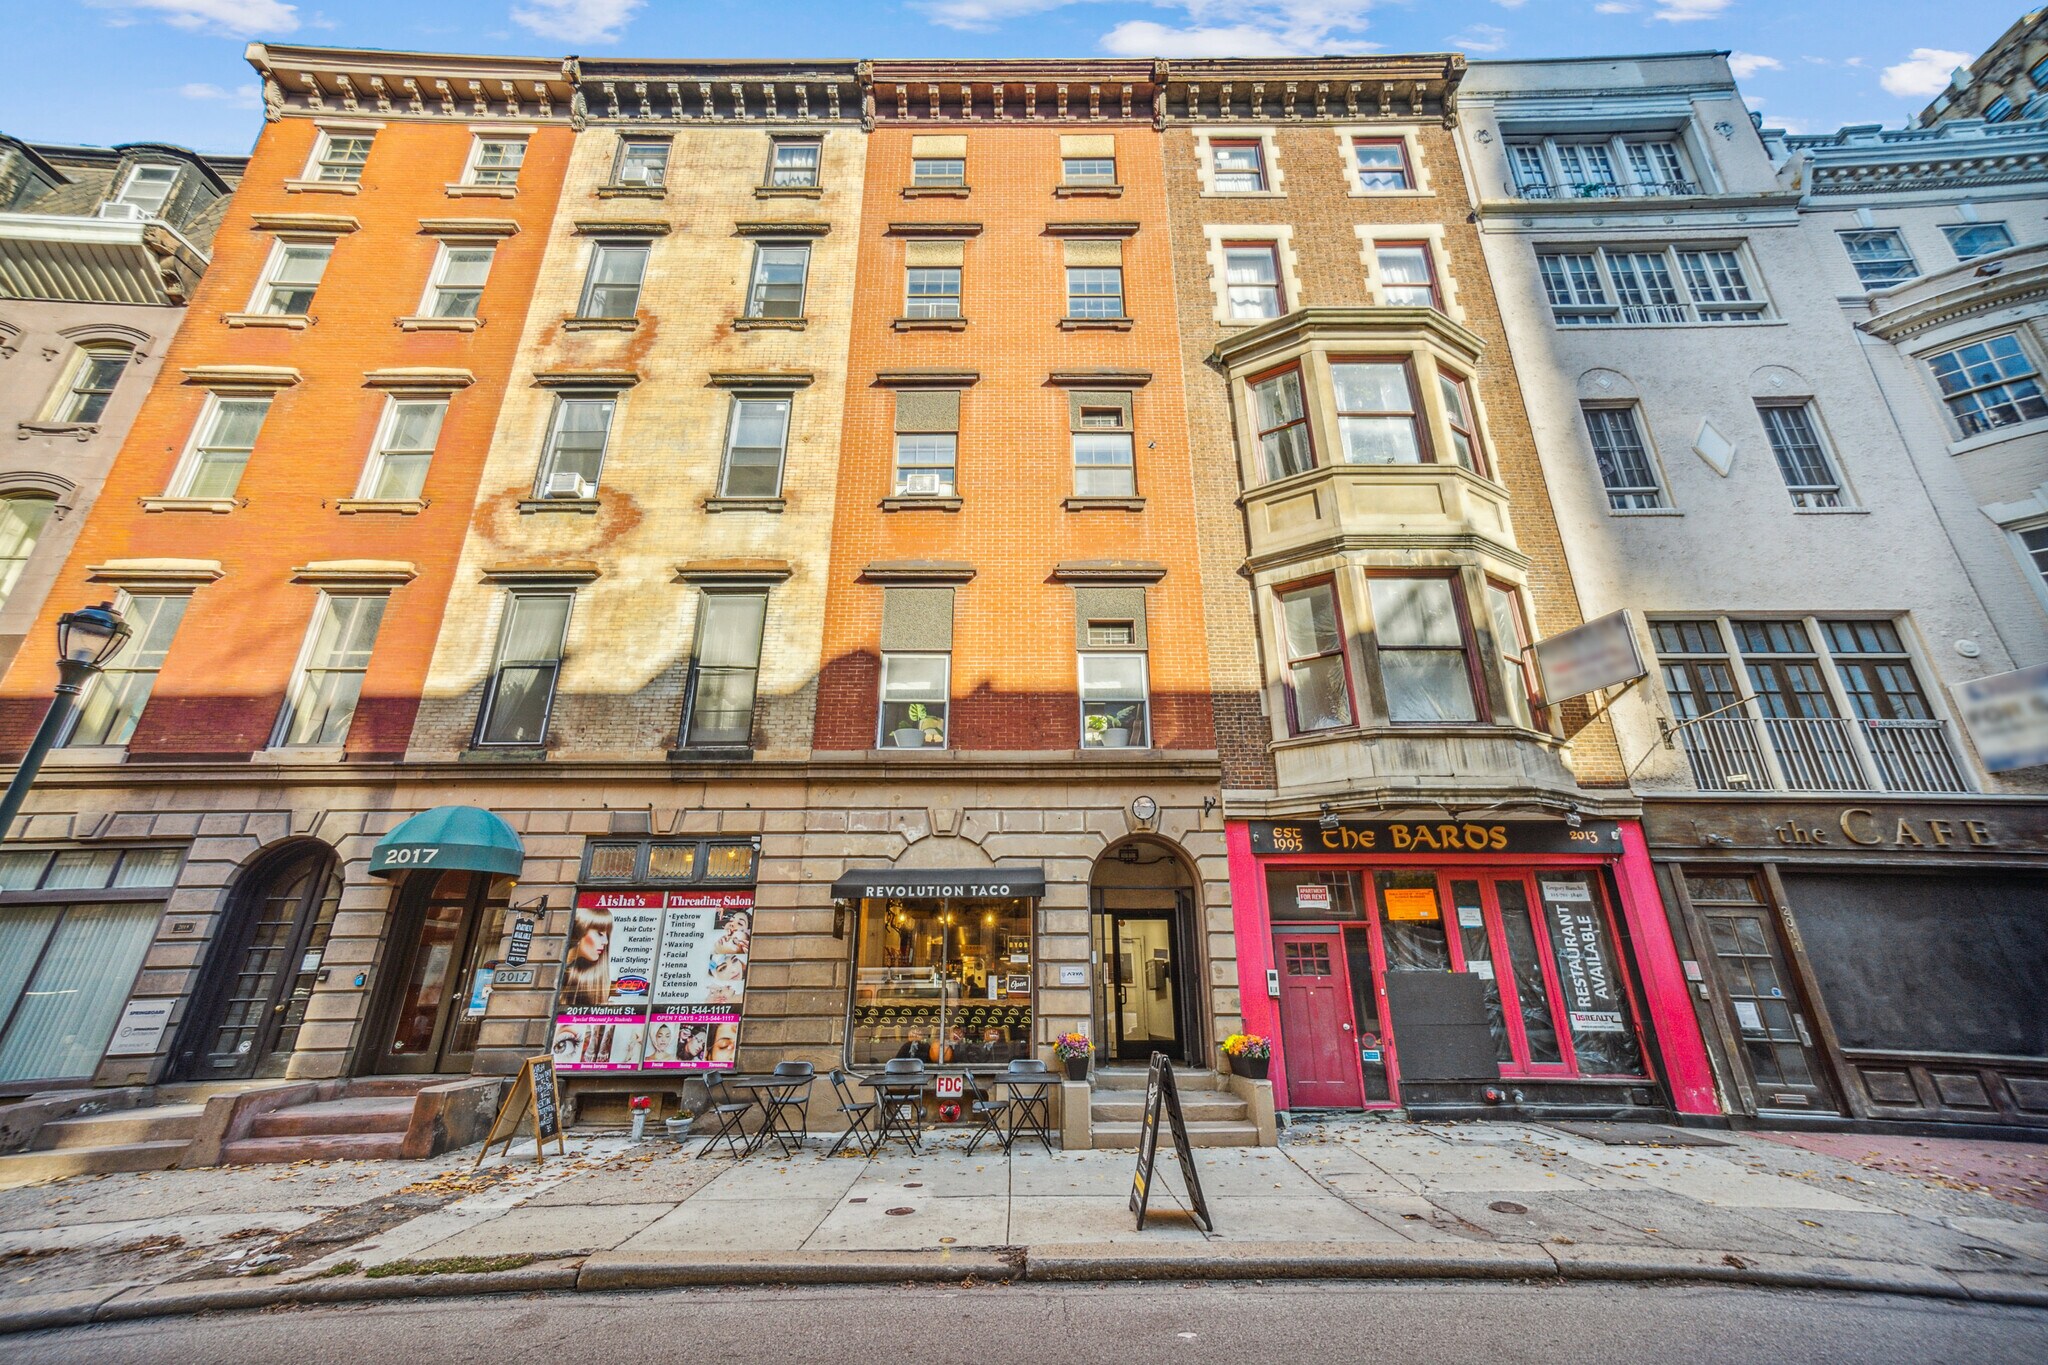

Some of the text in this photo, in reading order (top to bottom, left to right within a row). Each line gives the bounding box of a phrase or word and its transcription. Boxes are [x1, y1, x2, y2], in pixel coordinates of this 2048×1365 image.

[1776, 808, 1995, 847] the CAFE
[1388, 823, 1508, 851] BARDS
[1570, 830, 1598, 844] 2013
[1273, 838, 1303, 852] 1995
[384, 848, 439, 864] 2017
[866, 885, 1010, 896] REVOLUTION TACO
[596, 894, 646, 907] Aisha's
[670, 896, 750, 907] Threading Salon
[1781, 906, 1802, 952] 2011
[1556, 904, 1591, 1007] RESTAURANT
[1577, 916, 1609, 999] AVAILABLE
[500, 972, 528, 981] 2017
[616, 981, 648, 990] OPEN
[1011, 980, 1027, 990] Open
[666, 1006, 731, 1014] (215) 544-1117
[938, 1077, 962, 1092] FDC
